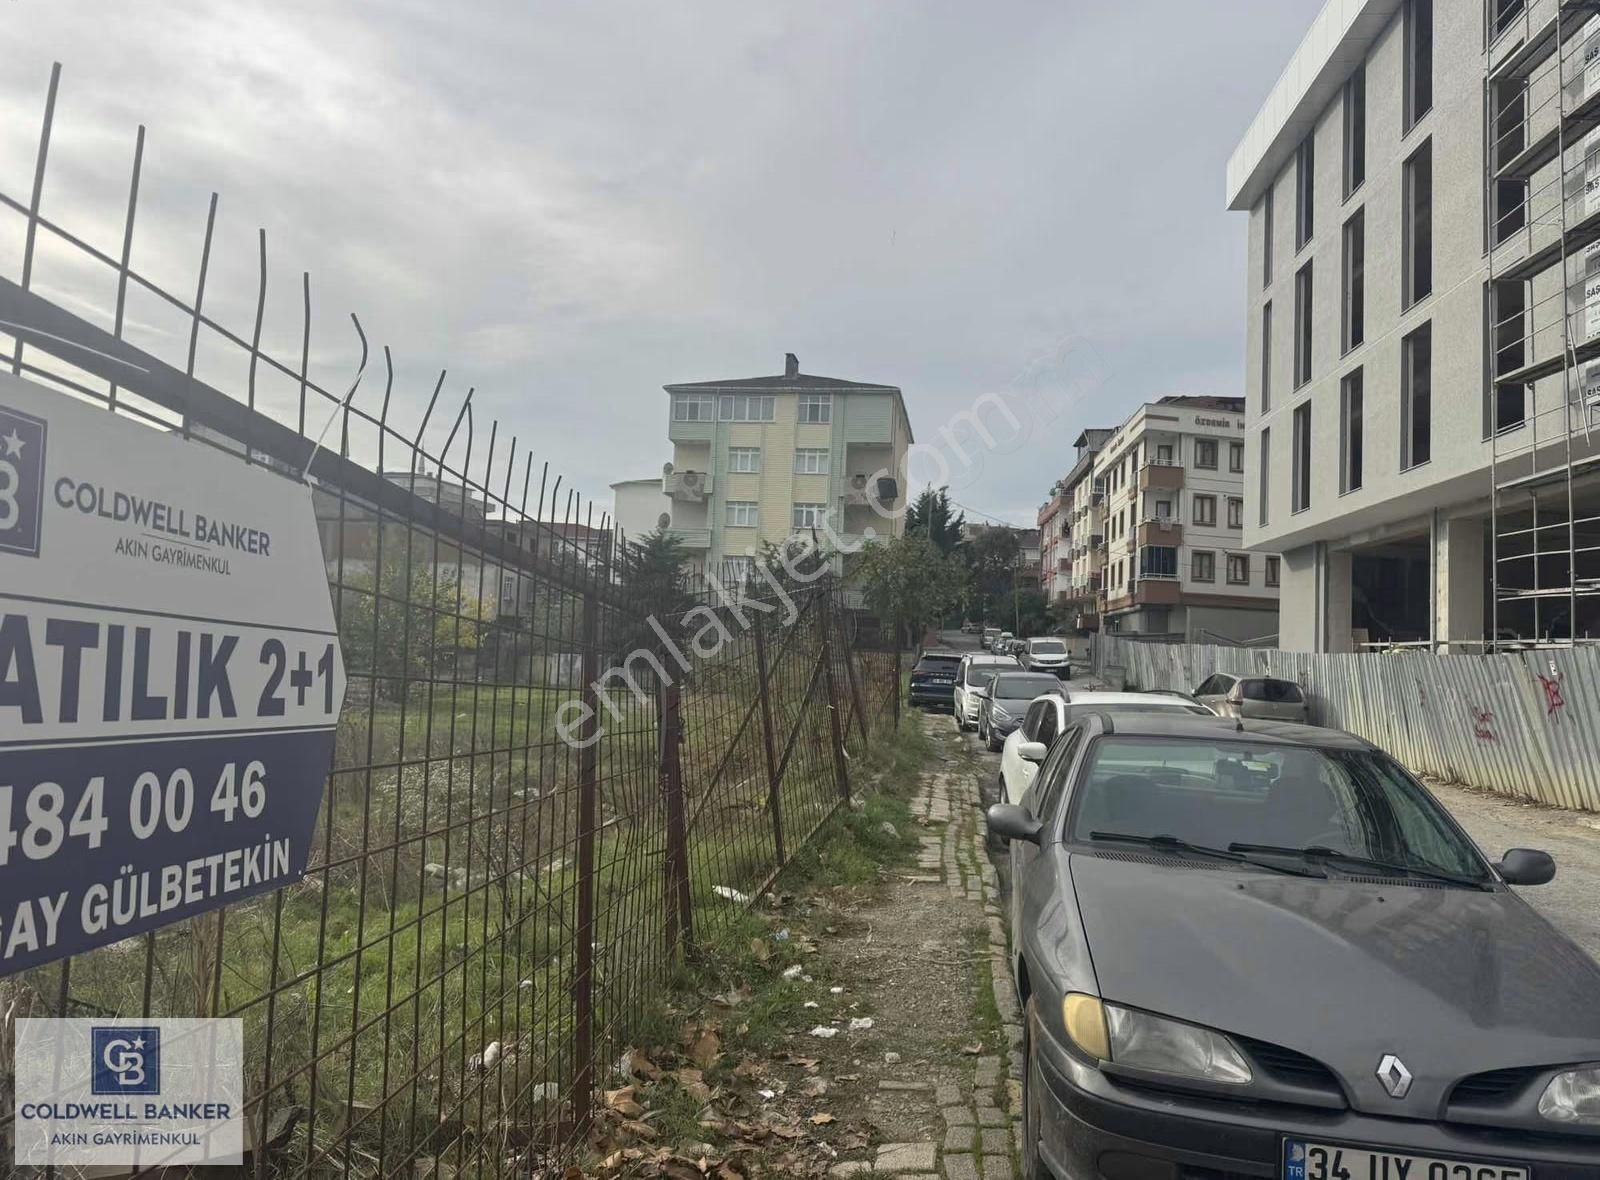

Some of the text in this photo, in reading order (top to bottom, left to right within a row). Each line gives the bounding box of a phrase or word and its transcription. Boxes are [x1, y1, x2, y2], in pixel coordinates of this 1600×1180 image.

[54, 476, 190, 538] COLDWELL
[195, 514, 270, 557] BANKER
[115, 537, 231, 576] AKIN GAYRİMENKUL
[257, 638, 334, 718] 2+1
[129, 767, 195, 841] 00
[210, 759, 267, 823] 46
[0, 832, 291, 960] AY GÜLBETEKİN
[1287, 1164, 1303, 1177] TR
[1308, 1147, 1350, 1180] 34
